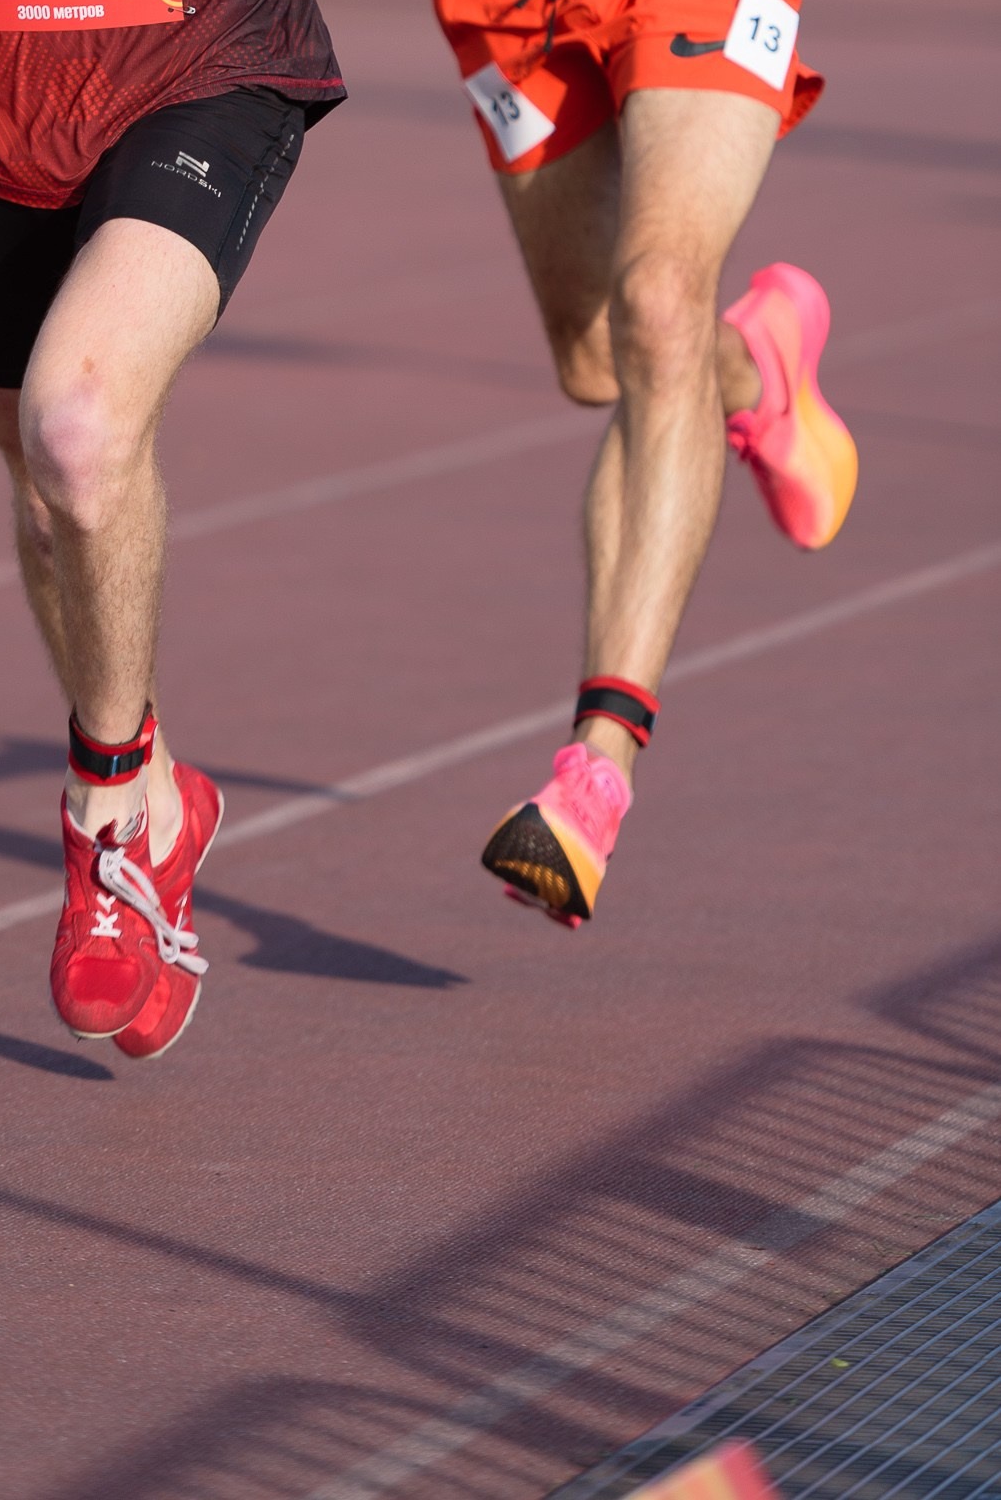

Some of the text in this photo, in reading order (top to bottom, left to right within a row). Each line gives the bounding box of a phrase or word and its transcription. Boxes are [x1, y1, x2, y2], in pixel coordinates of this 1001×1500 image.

[17, 4, 105, 20] 3000 метров
[748, 14, 782, 53] 13
[492, 91, 520, 125] 13
[151, 159, 222, 198] NORDSKI
